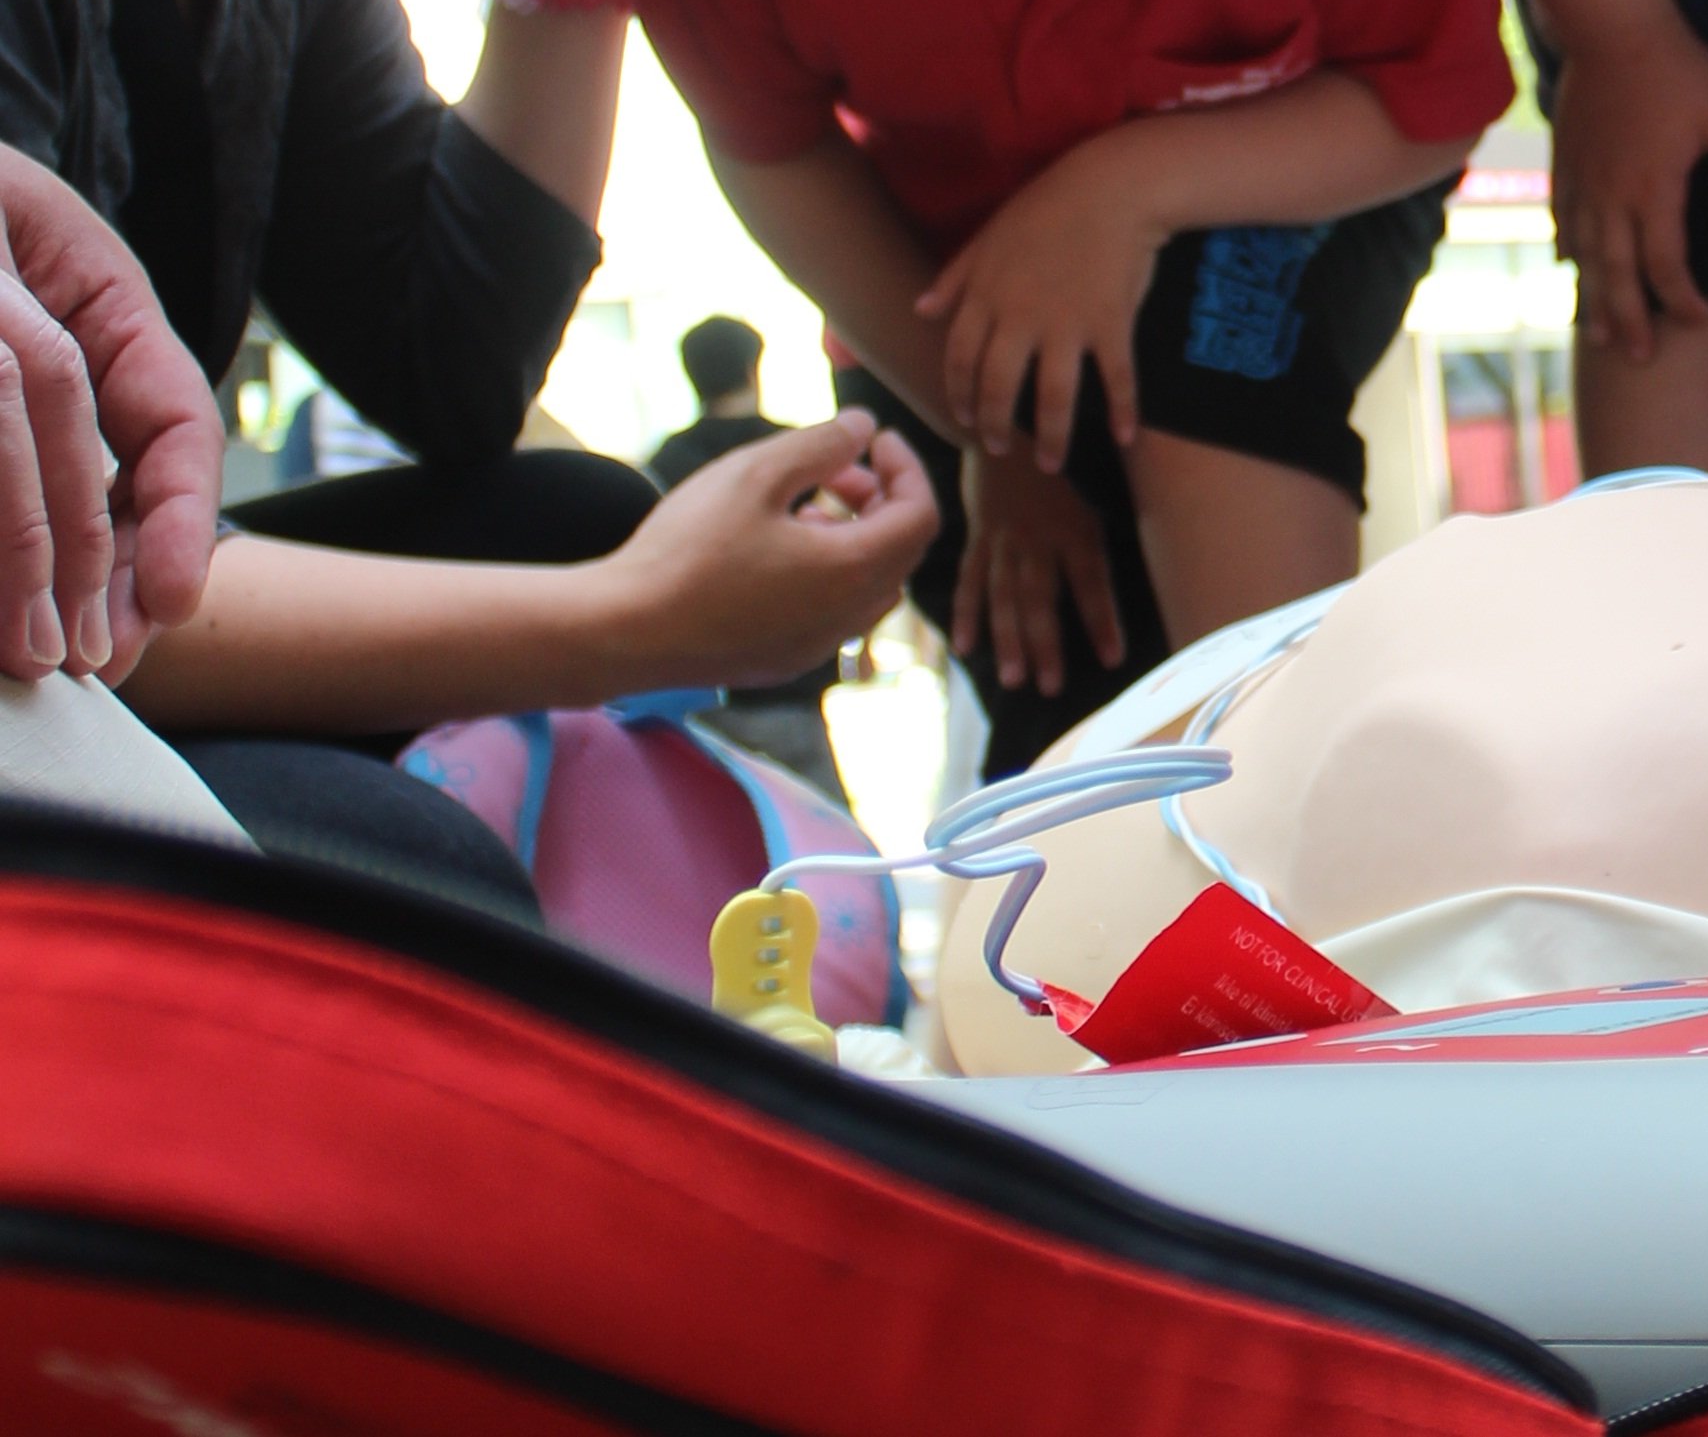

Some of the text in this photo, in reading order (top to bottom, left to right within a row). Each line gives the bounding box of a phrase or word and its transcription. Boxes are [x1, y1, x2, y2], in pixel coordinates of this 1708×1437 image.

[1229, 926, 1261, 953] NOT
[1257, 944, 1288, 973] FOR
[1284, 965, 1342, 1014] CLINICAL
